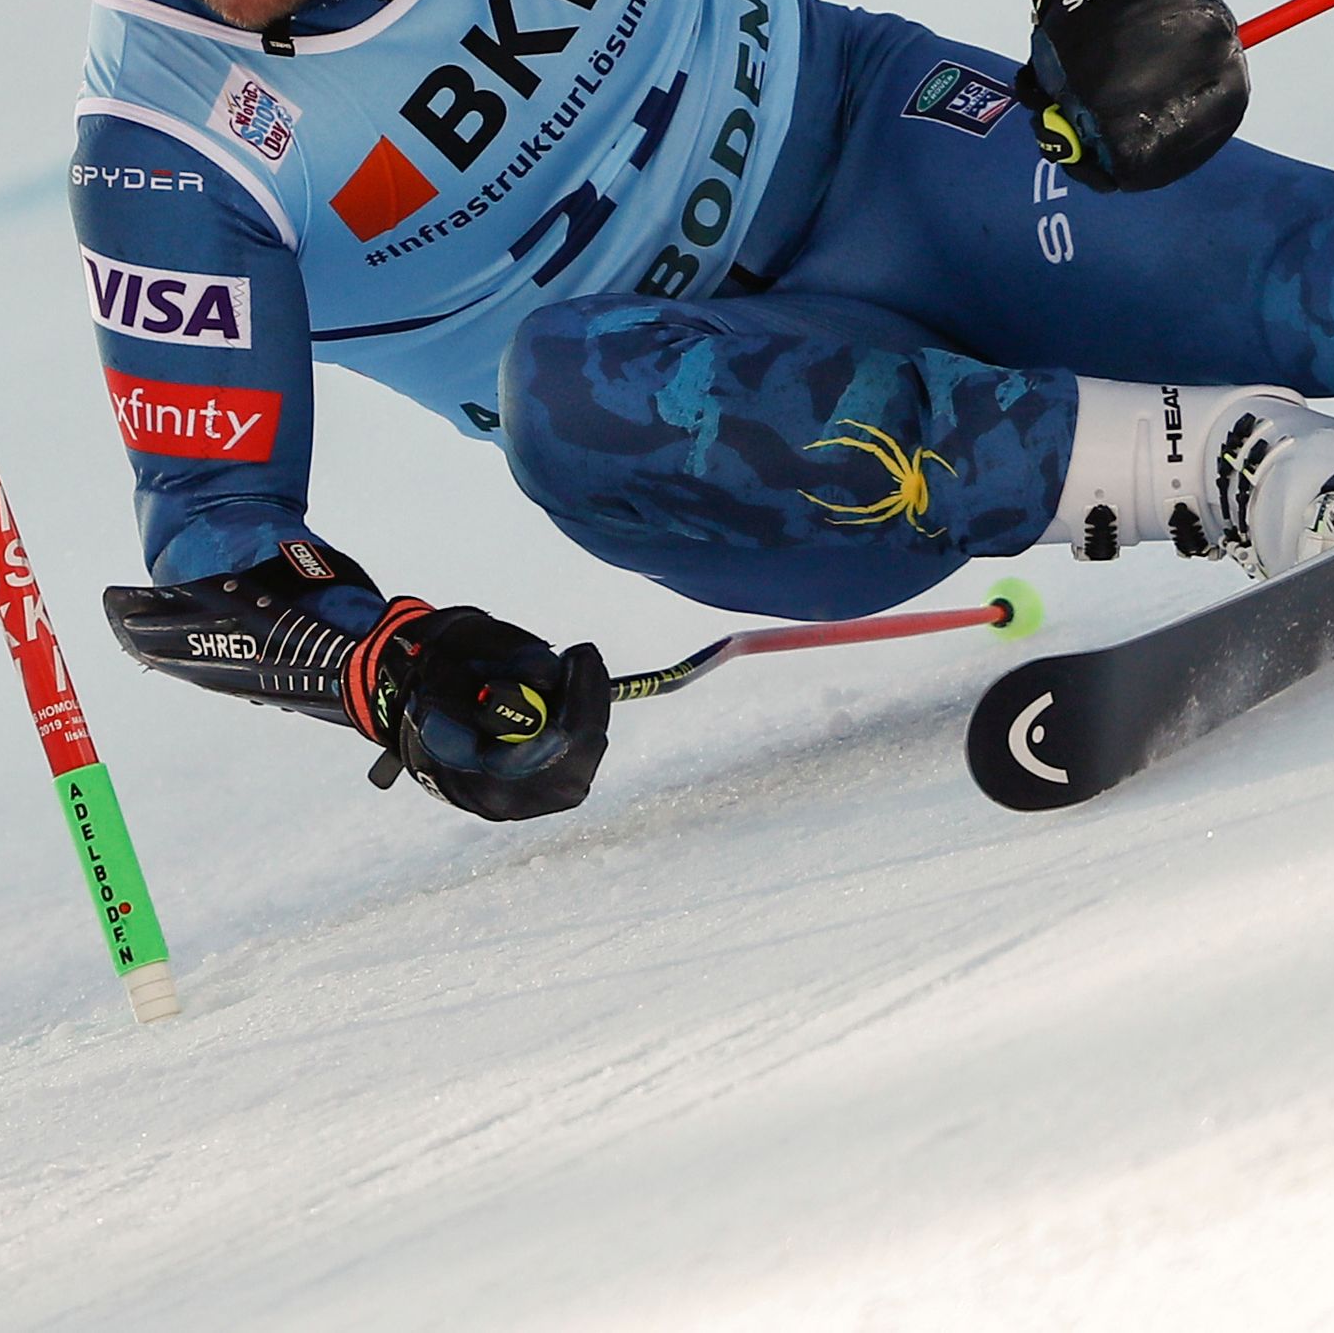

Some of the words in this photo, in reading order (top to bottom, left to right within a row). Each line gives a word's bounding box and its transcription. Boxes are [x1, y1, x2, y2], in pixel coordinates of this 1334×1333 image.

[235, 87, 258, 126] World
[948, 83, 983, 111] US
[241, 95, 274, 146] Snow
[264, 121, 288, 153] Day
[70, 164, 205, 192] SPYDER
[83, 255, 240, 340] VISA
[112, 388, 262, 450] xfinity
[495, 704, 535, 727] LEKI
[70, 782, 134, 965] ADELBODEN
